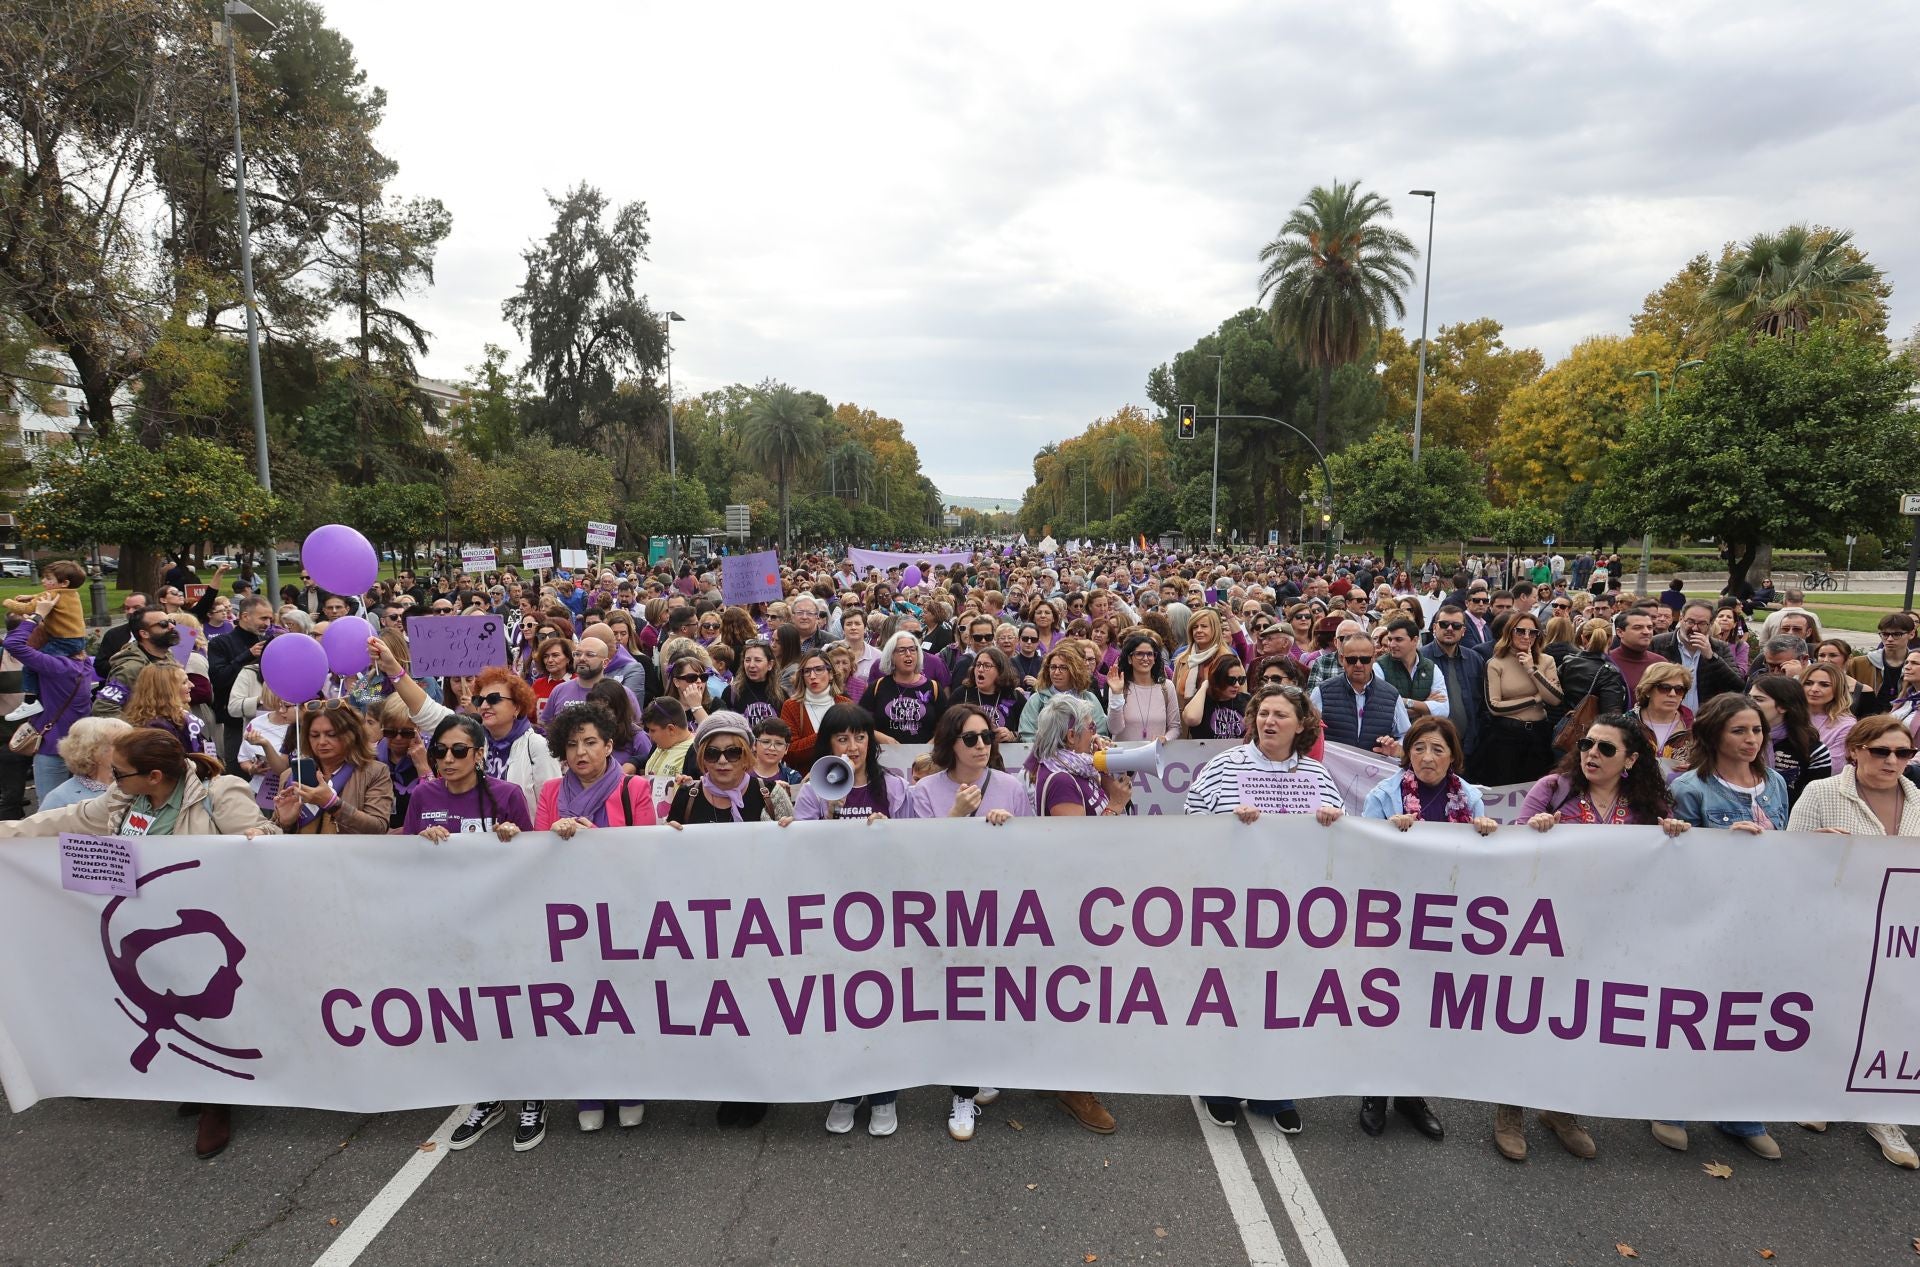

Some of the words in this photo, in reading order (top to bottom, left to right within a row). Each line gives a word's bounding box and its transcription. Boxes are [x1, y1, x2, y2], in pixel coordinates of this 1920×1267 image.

[588, 522, 615, 532] HINOJOSA
[523, 546, 550, 555] HINOJOSA
[892, 697, 921, 709] VIVAS
[67, 838, 114, 847] TRABAJAR
[63, 845, 109, 854] IGUALDAD
[110, 850, 131, 858] PARA
[65, 852, 117, 862] CONSTRUIR
[73, 859, 108, 867] MUNDO
[72, 866, 125, 877] VIOLENCIAS
[72, 873, 126, 883] MACHISTAS.
[545, 889, 1055, 963] PLATAFORMA
[1078, 886, 1565, 958] CORDOBESA
[321, 978, 635, 1047] CONTRA
[655, 979, 750, 1037] LA
[767, 964, 1168, 1036] VIOLENCIA
[1186, 967, 1238, 1028] A
[1264, 967, 1401, 1030] LAS
[1429, 971, 1814, 1052] MUJERES
[1863, 1049, 1887, 1079] A
